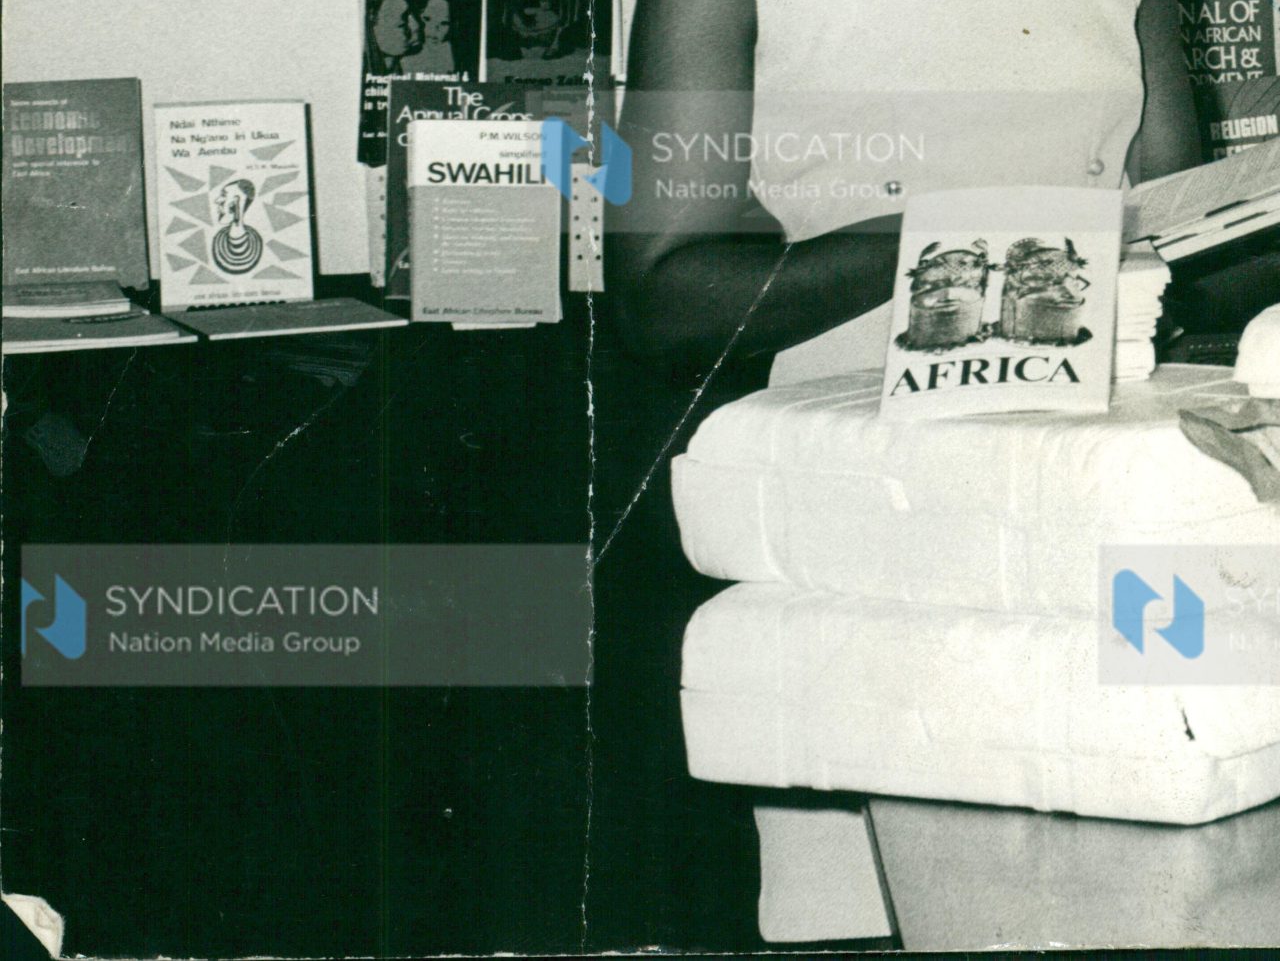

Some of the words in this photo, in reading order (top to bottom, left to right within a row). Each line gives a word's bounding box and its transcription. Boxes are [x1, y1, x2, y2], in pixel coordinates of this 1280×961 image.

[1229, 0, 1260, 24] OF
[443, 87, 484, 106] The
[396, 105, 468, 124] Annual
[503, 132, 548, 141] WILSON
[1210, 114, 1278, 141] RELIGION
[170, 135, 186, 144] Na
[171, 149, 190, 158] Wa
[427, 161, 547, 184] SWAHILI
[888, 355, 1081, 397] AFRICA
